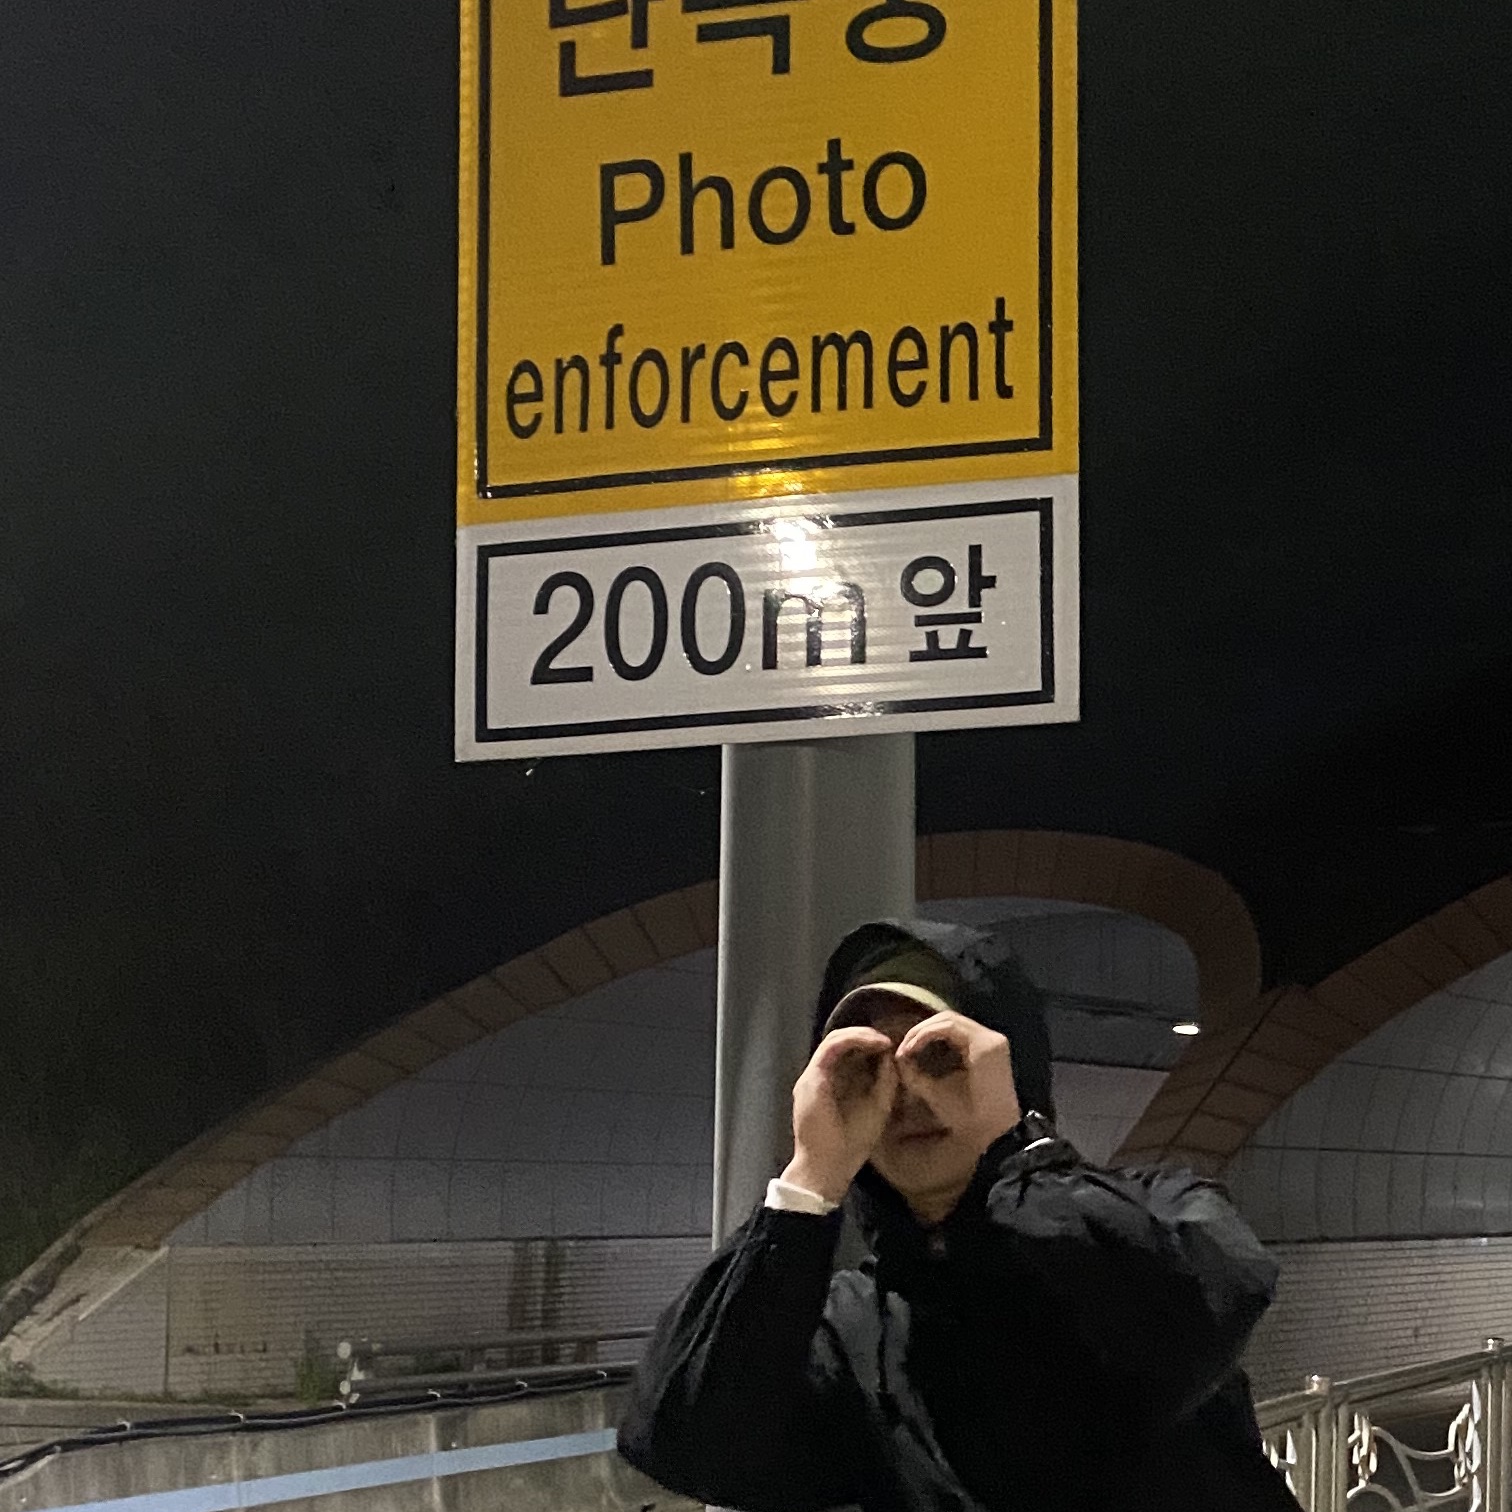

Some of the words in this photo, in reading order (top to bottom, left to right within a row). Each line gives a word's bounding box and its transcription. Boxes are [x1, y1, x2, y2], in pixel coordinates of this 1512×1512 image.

[599, 138, 927, 265] Photo
[505, 297, 1013, 438] enforcement
[530, 562, 867, 685] 200m
[900, 543, 997, 662] 앞
